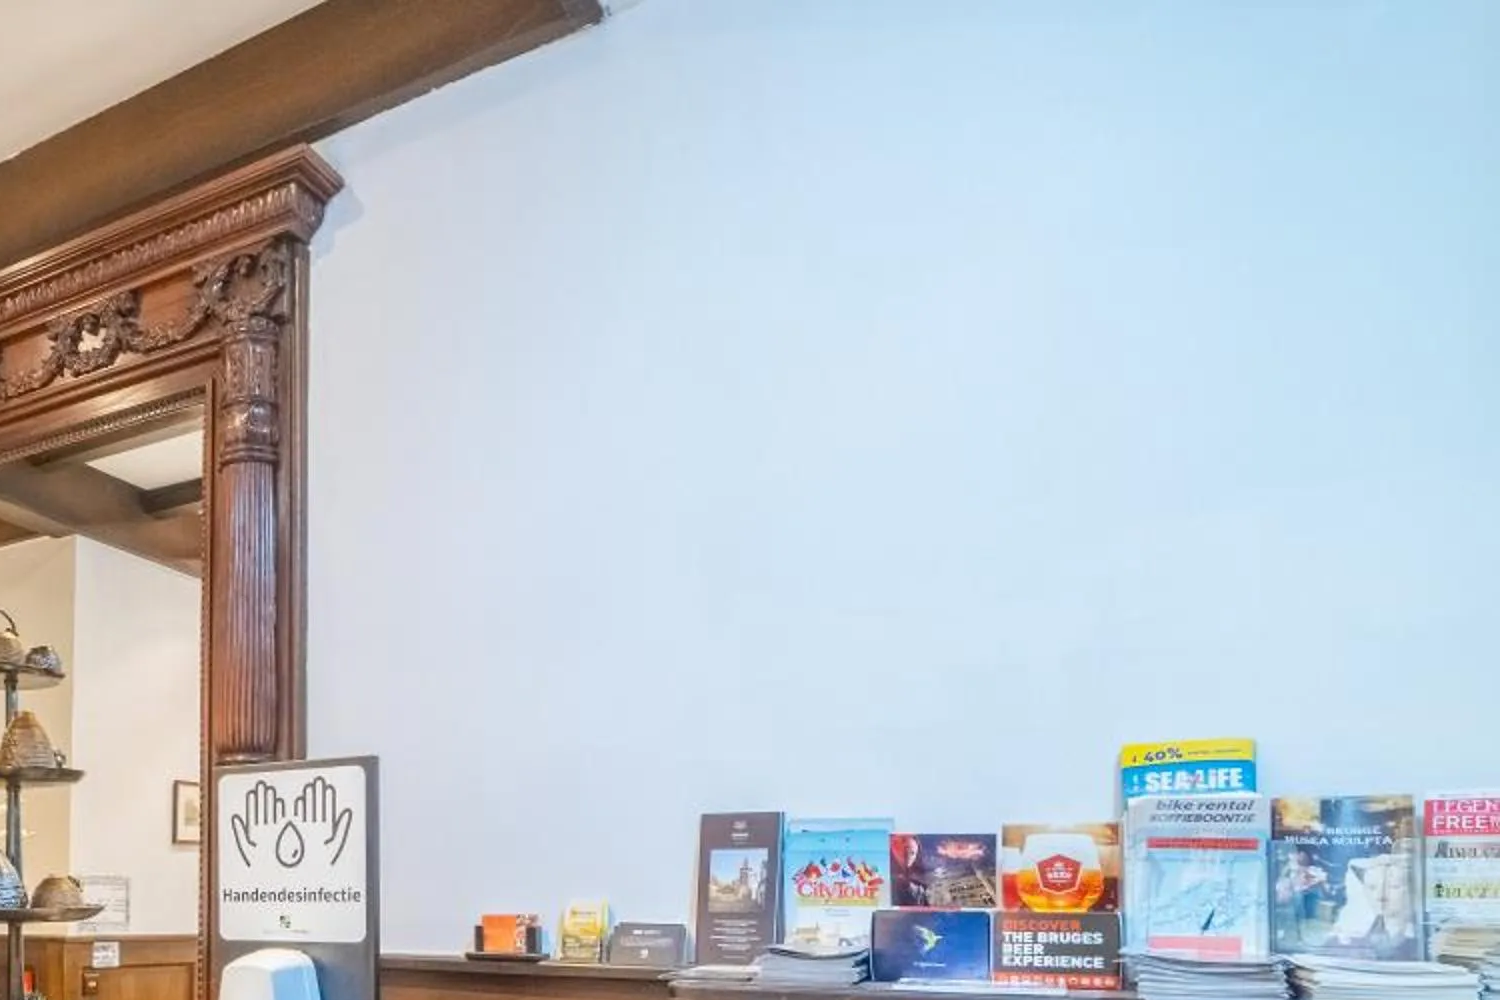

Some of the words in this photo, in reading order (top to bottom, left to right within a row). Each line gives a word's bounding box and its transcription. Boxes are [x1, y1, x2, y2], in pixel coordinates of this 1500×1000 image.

[1144, 770, 1192, 793] SEA
[1156, 799, 1194, 811] bike
[1197, 799, 1255, 811] rental
[1432, 815, 1488, 829] FREE
[223, 887, 362, 903] Handendesinfectie
[1003, 919, 1082, 931] DISCOVER
[1002, 931, 1034, 943] THE
[1037, 931, 1104, 944] BRUGES
[1002, 943, 1045, 955] BEER
[1002, 955, 1105, 969] EXPERIENCE
